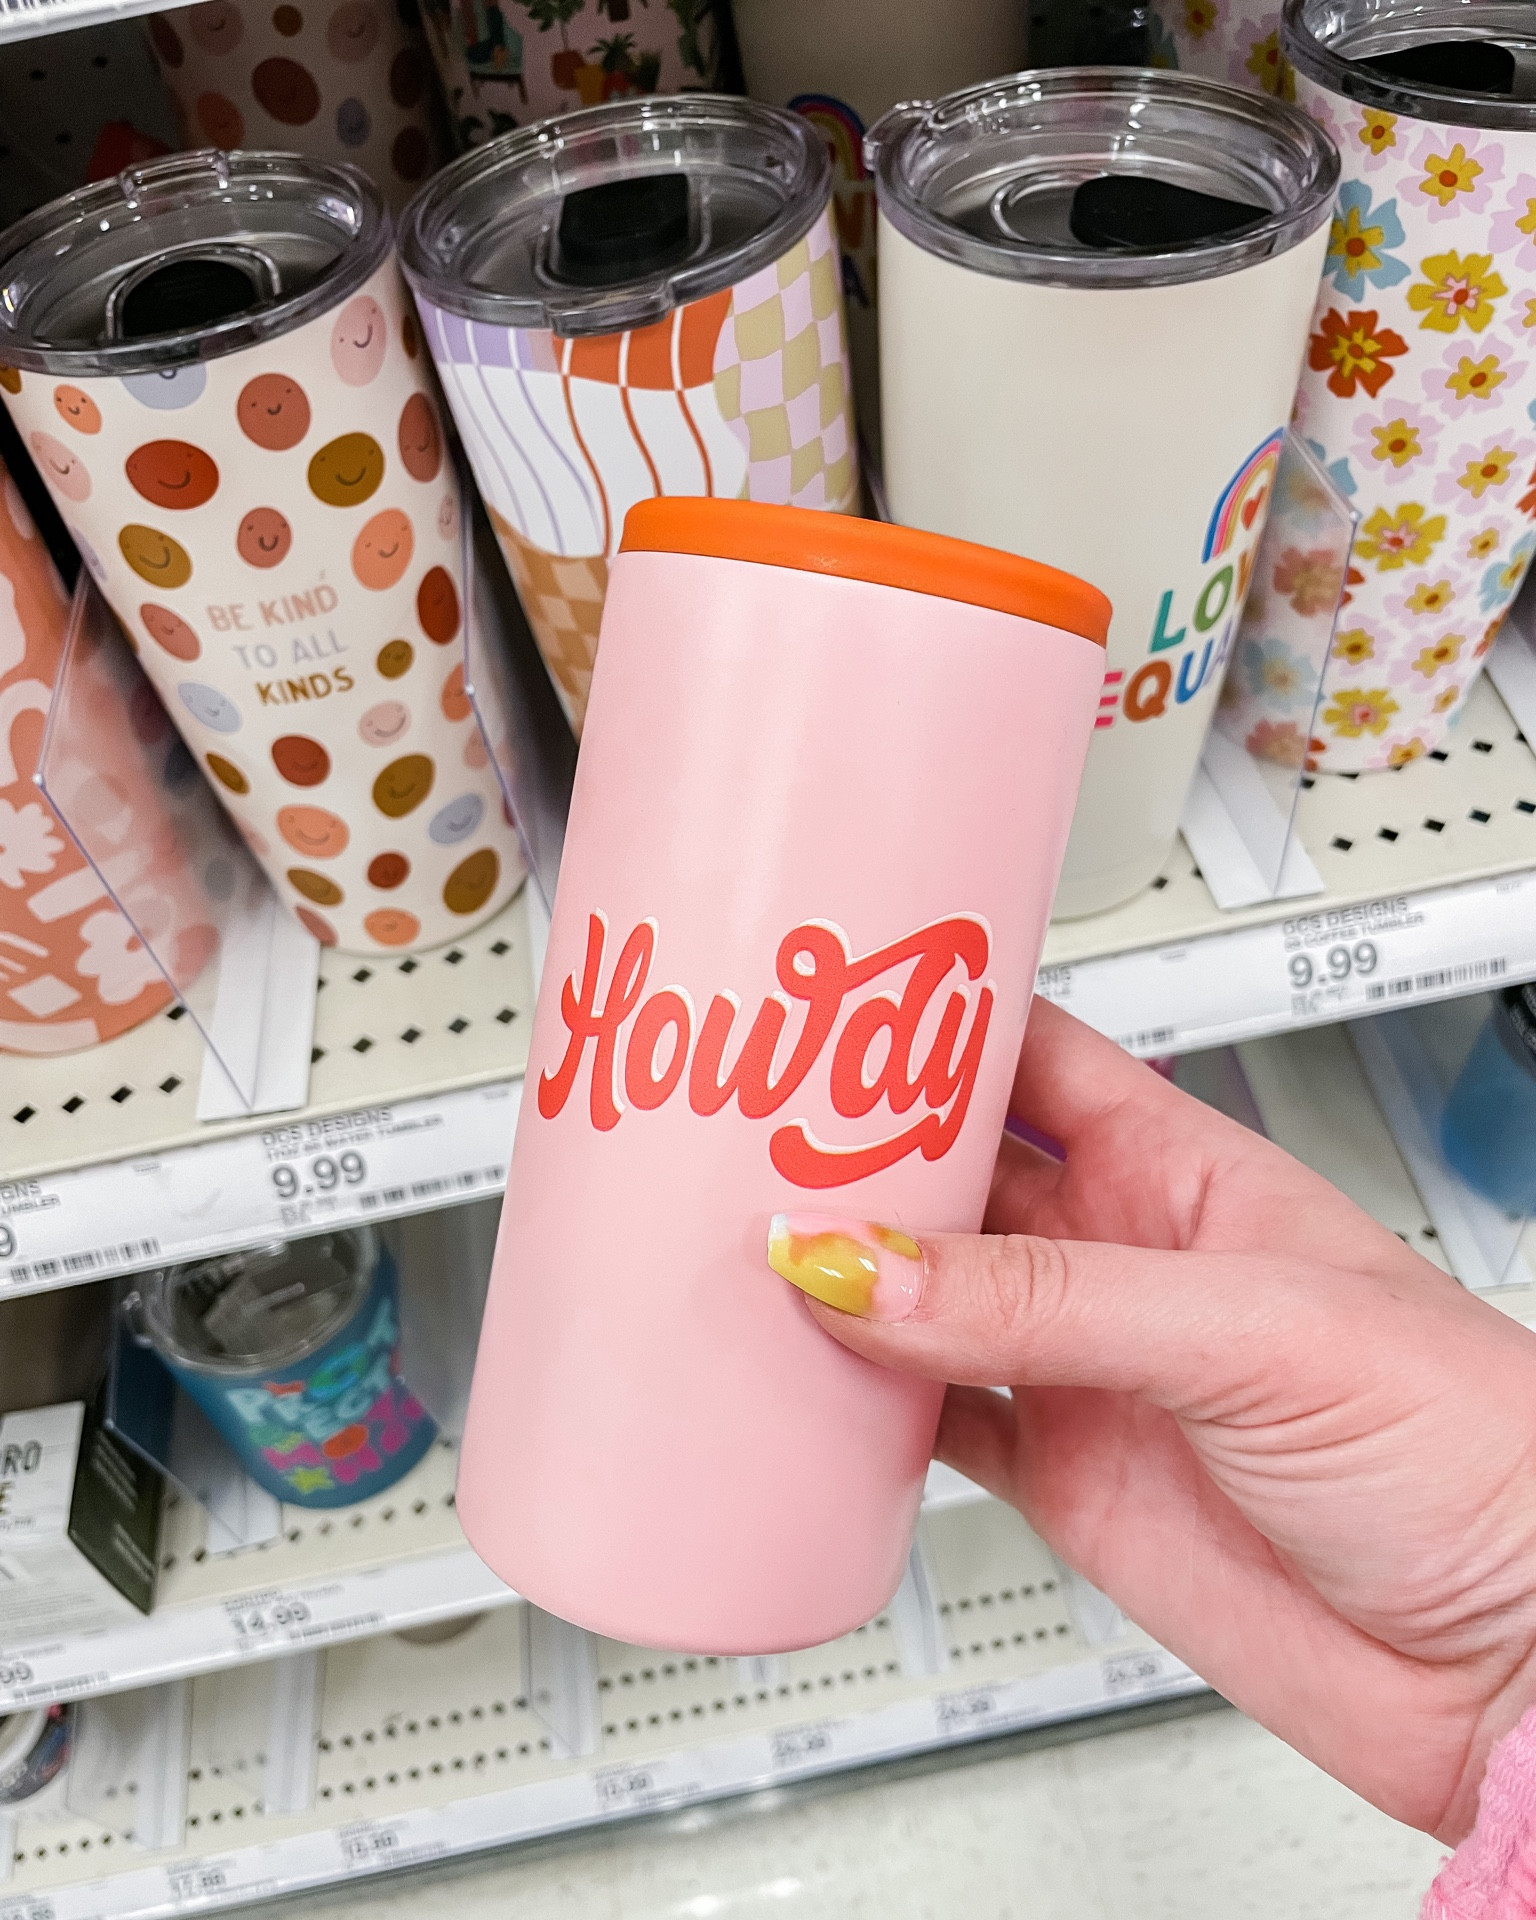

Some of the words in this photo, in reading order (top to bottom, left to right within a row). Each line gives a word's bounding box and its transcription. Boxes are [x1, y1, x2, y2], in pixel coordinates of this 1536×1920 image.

[206, 603, 252, 631] BE
[258, 585, 338, 626] KIND
[233, 644, 277, 670] TO
[292, 629, 349, 664] ALL
[256, 666, 354, 706] KINDS
[1288, 941, 1378, 989] 9.99
[538, 907, 997, 1189] Howdy
[273, 1152, 365, 1198] 9.99
